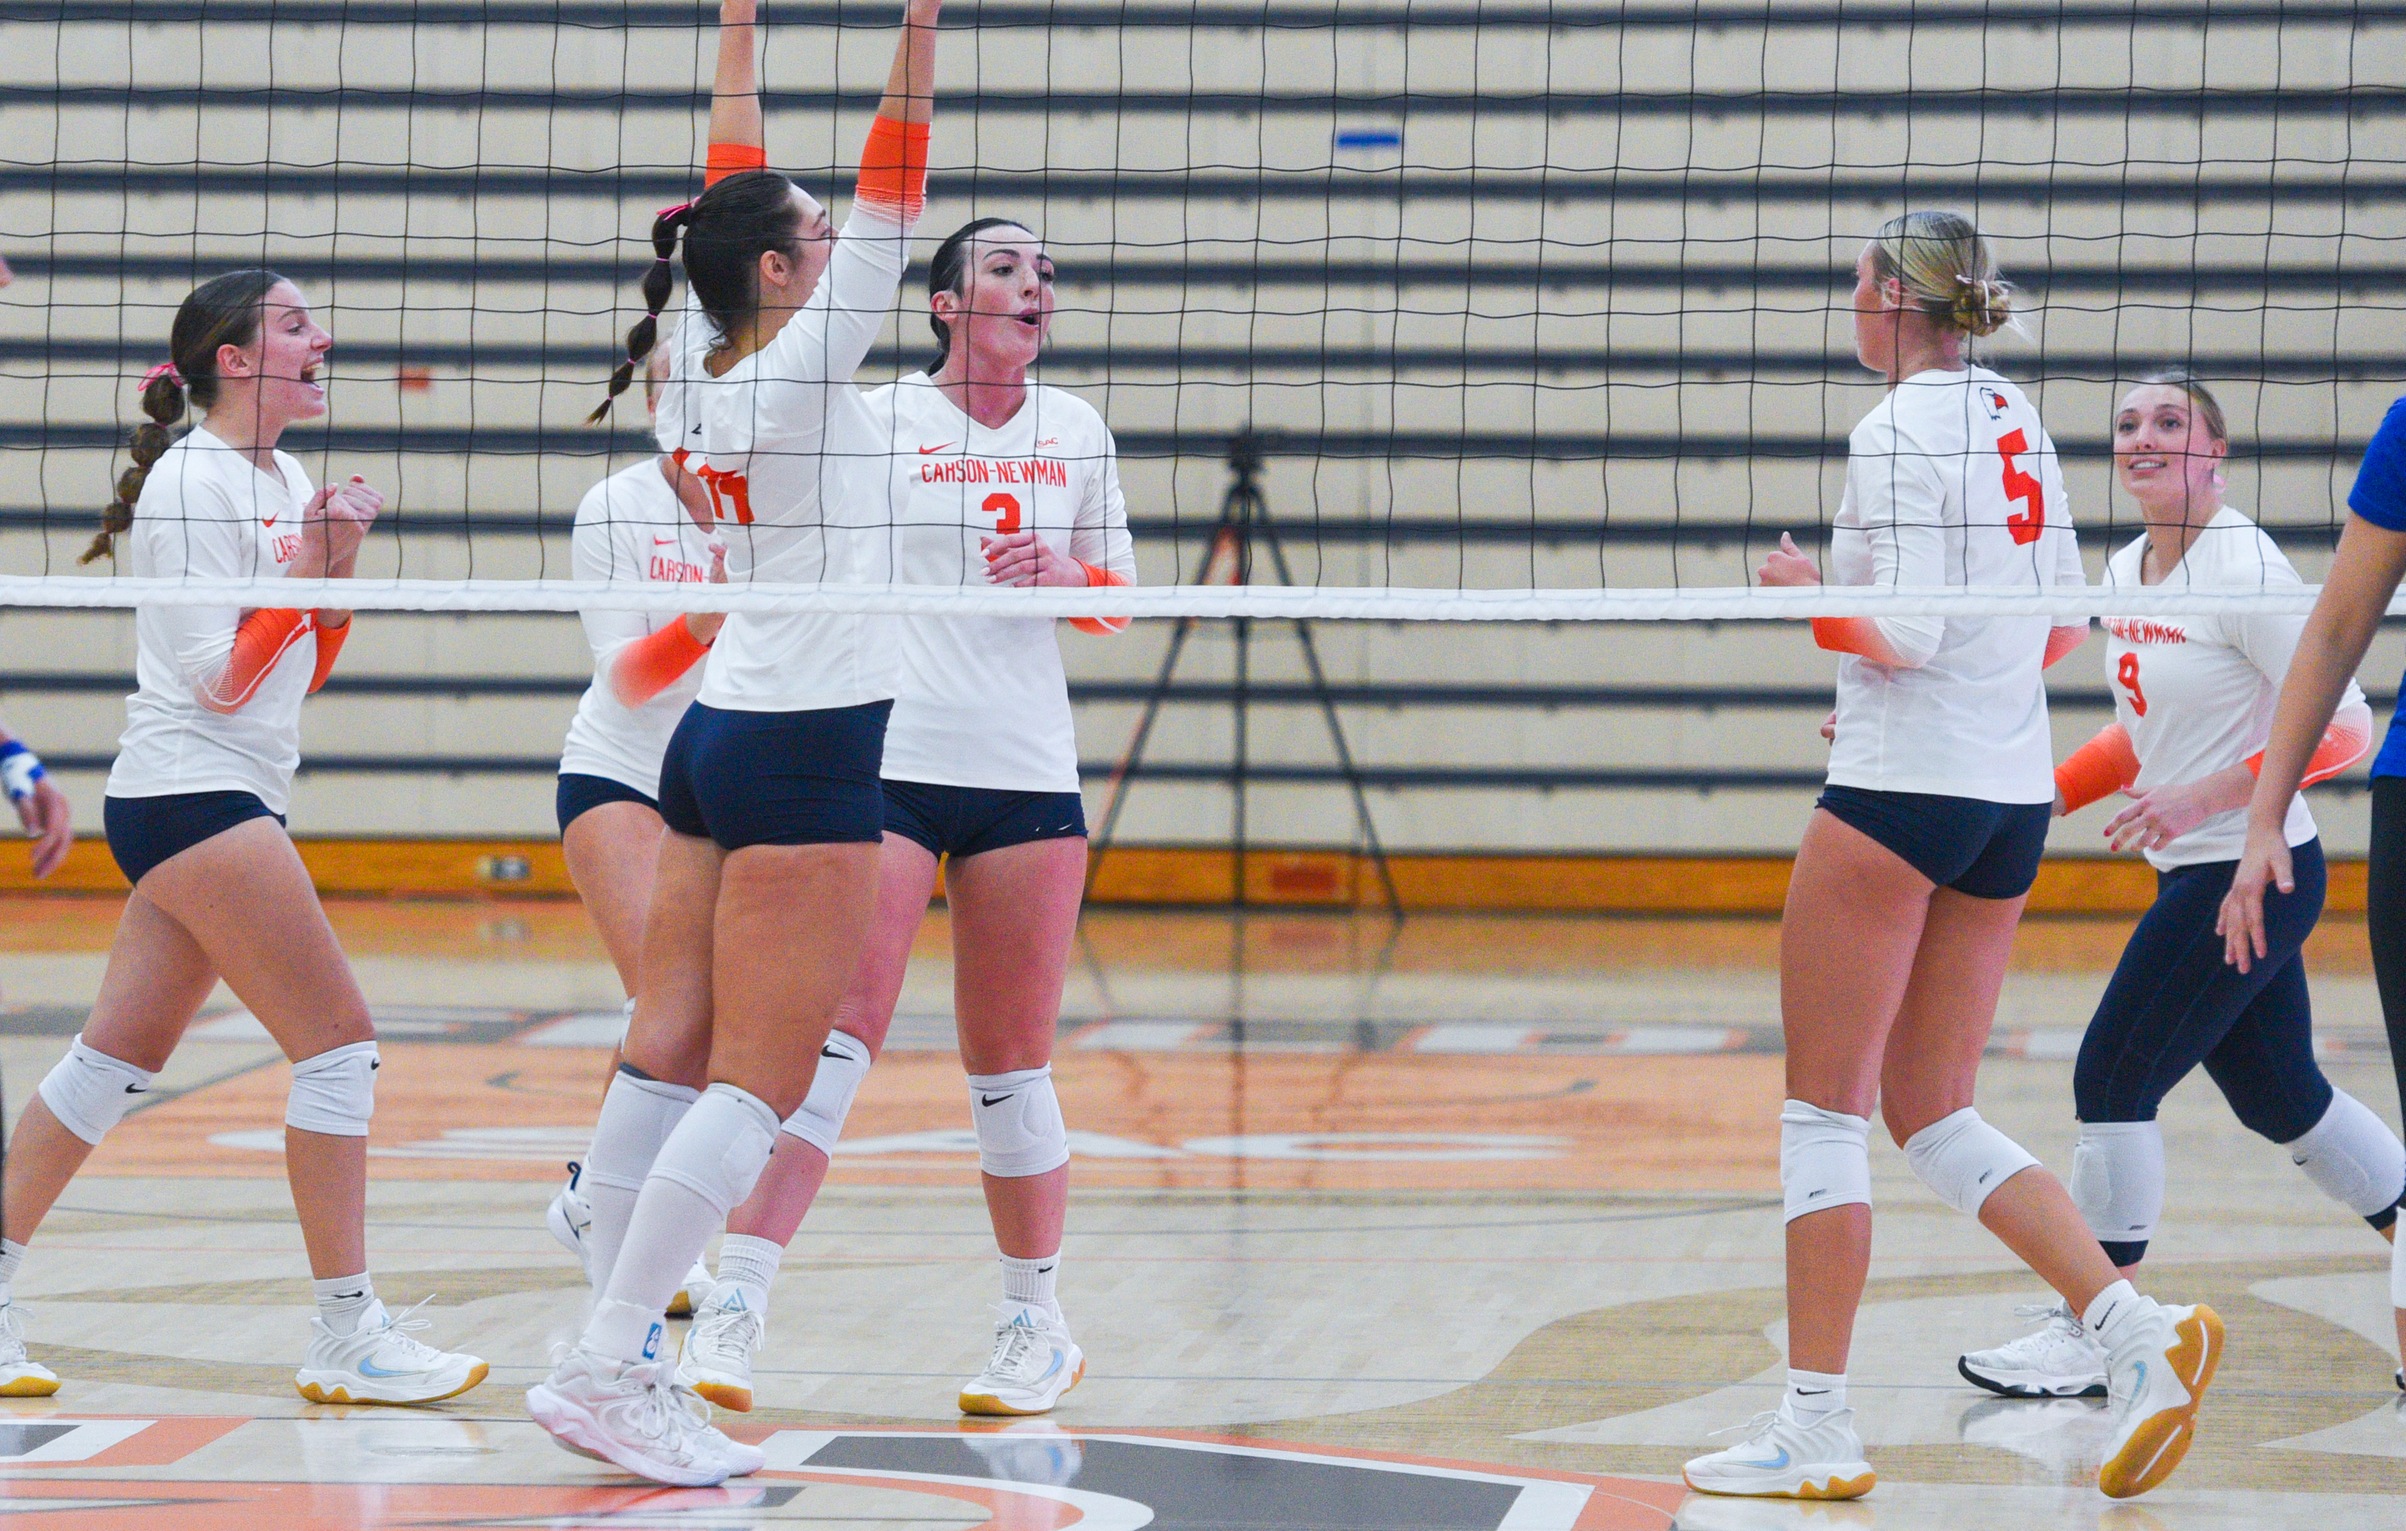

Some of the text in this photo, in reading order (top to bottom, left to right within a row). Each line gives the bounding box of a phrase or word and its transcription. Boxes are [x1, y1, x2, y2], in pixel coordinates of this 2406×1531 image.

[920, 458, 1068, 488] CARSON-NEWMAN
[1996, 427, 2046, 546] 5
[980, 492, 1021, 562] 3
[2117, 651, 2148, 718] 9
